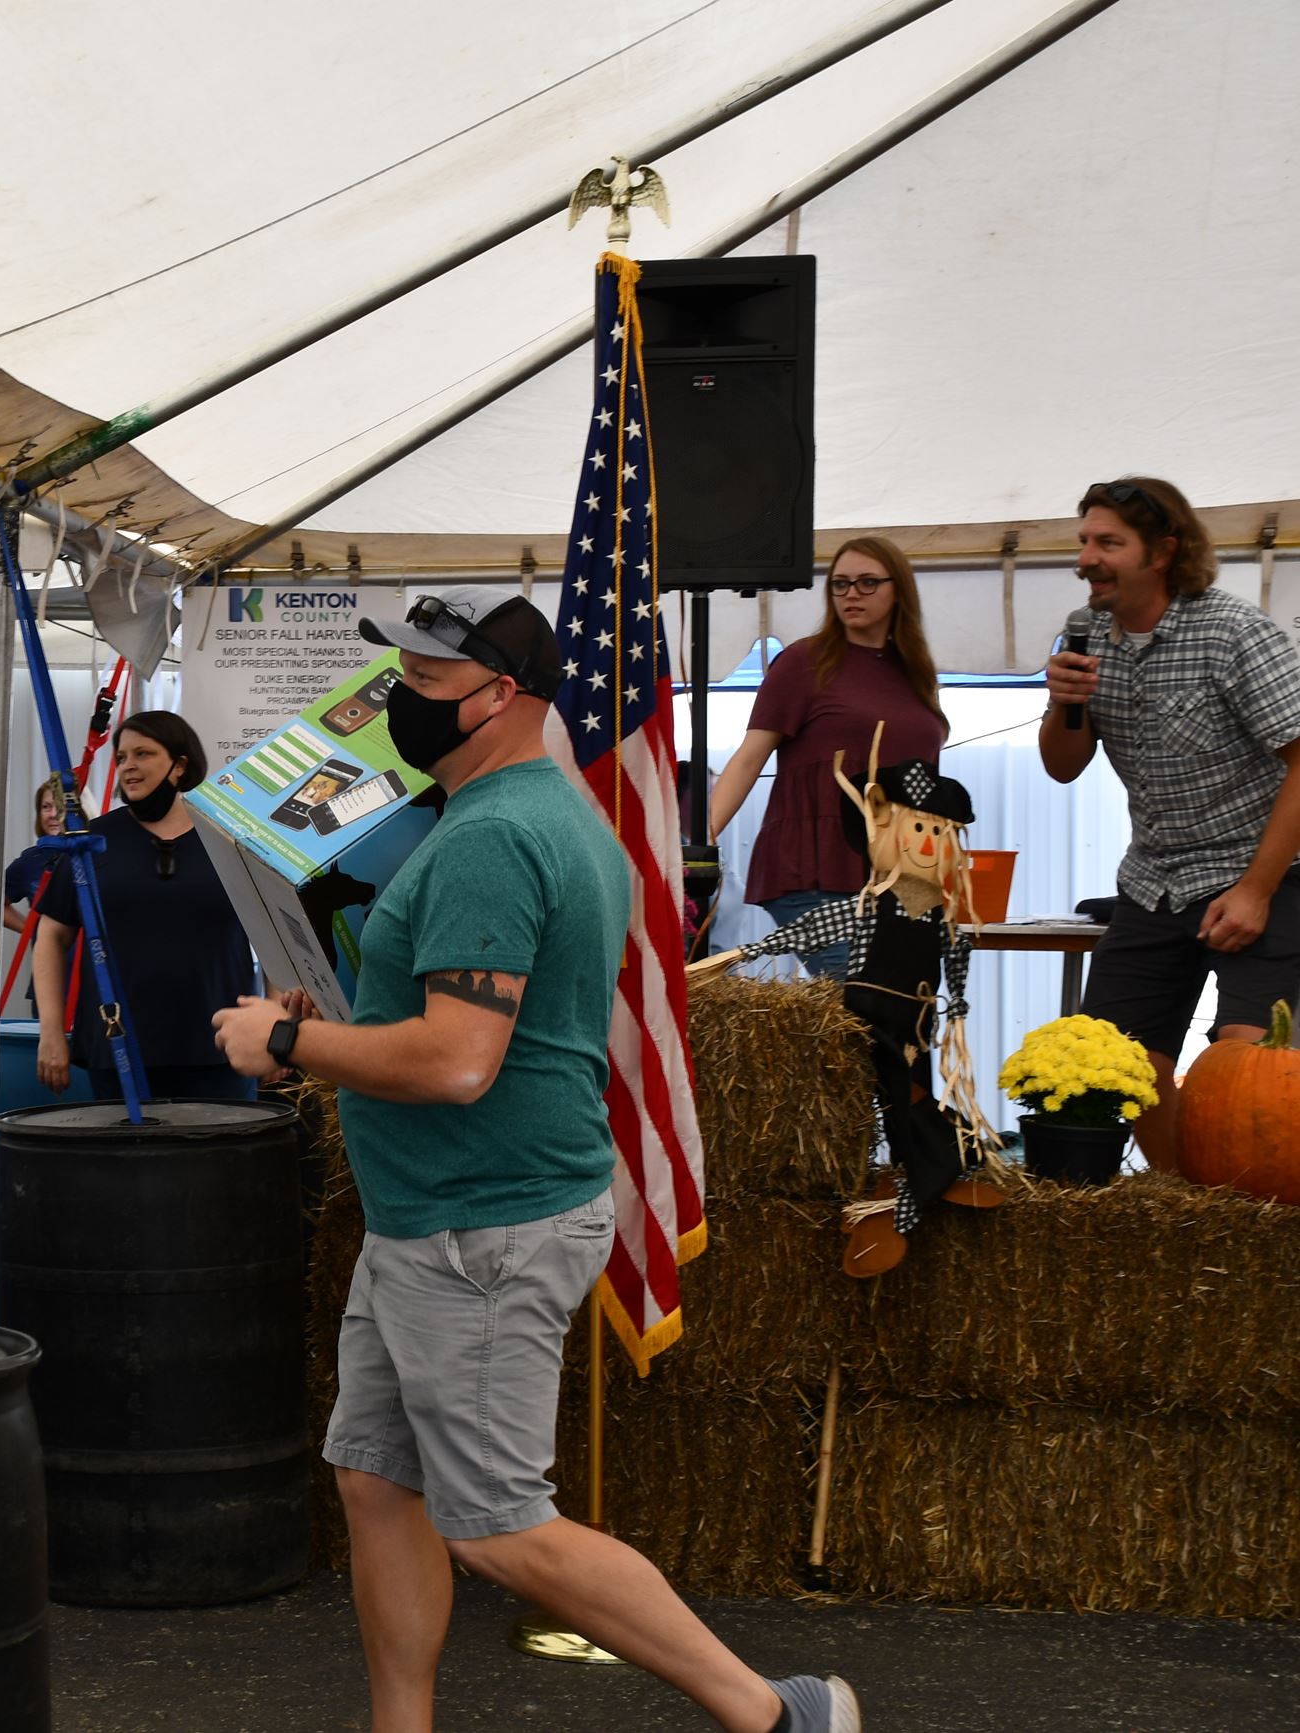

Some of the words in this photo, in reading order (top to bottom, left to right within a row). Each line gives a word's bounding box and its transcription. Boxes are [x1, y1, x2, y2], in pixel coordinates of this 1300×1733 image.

[275, 593, 357, 608] KENTON
[280, 611, 352, 623] COUNTY
[215, 629, 268, 641] SENIOR
[270, 629, 303, 641] FALL
[306, 629, 361, 641] HARVES
[222, 648, 253, 657] MOST
[255, 648, 300, 657] SPECIAL
[303, 648, 346, 657] THANKS
[349, 648, 364, 657] TO
[214, 659, 239, 669] OUR
[240, 659, 308, 669] PRESENTING
[254, 674, 285, 684] DUKE
[286, 674, 331, 684] ENERGY
[249, 686, 310, 695] HUNTINGTON
[239, 707, 281, 717] Bluegrass
